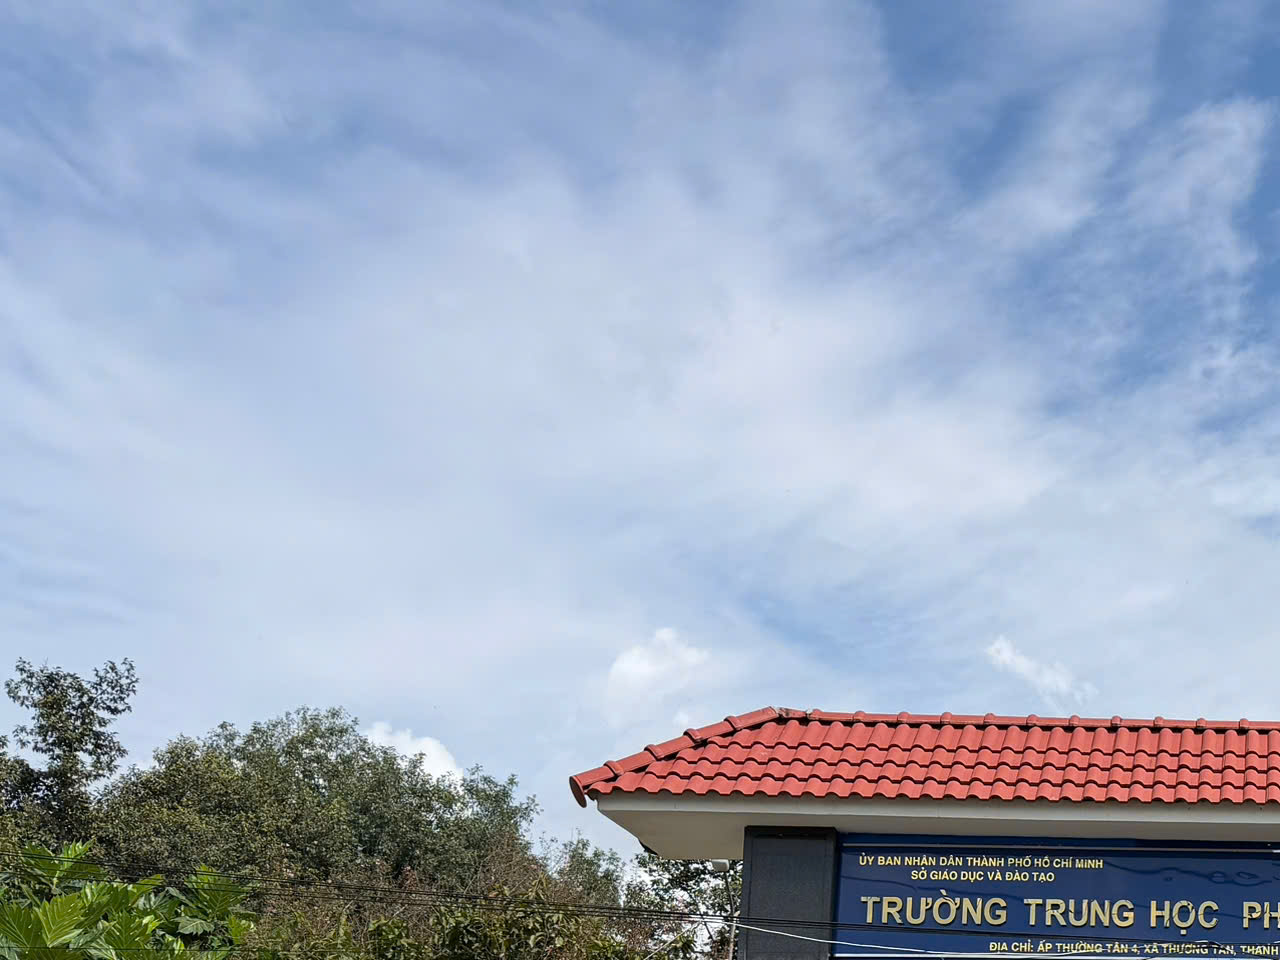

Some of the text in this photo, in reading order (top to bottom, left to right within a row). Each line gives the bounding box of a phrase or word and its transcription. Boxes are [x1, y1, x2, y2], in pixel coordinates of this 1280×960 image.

[859, 852, 874, 866] ỦY
[878, 856, 900, 866] BAN
[904, 854, 935, 866] NHÂN
[940, 854, 962, 867] DÂN
[966, 854, 1004, 867] THÀNH
[1008, 855, 1031, 867] PHỐ
[1053, 856, 1072, 868] CHÍ
[1076, 858, 1104, 869] MINH
[911, 868, 1055, 883] SỞ GIÁO DỤC VÀ ĐÀO TẠO
[860, 889, 1007, 925] TRƯỜNG
[1023, 898, 1134, 928] TRUNG
[1150, 899, 1219, 935] HỌC
